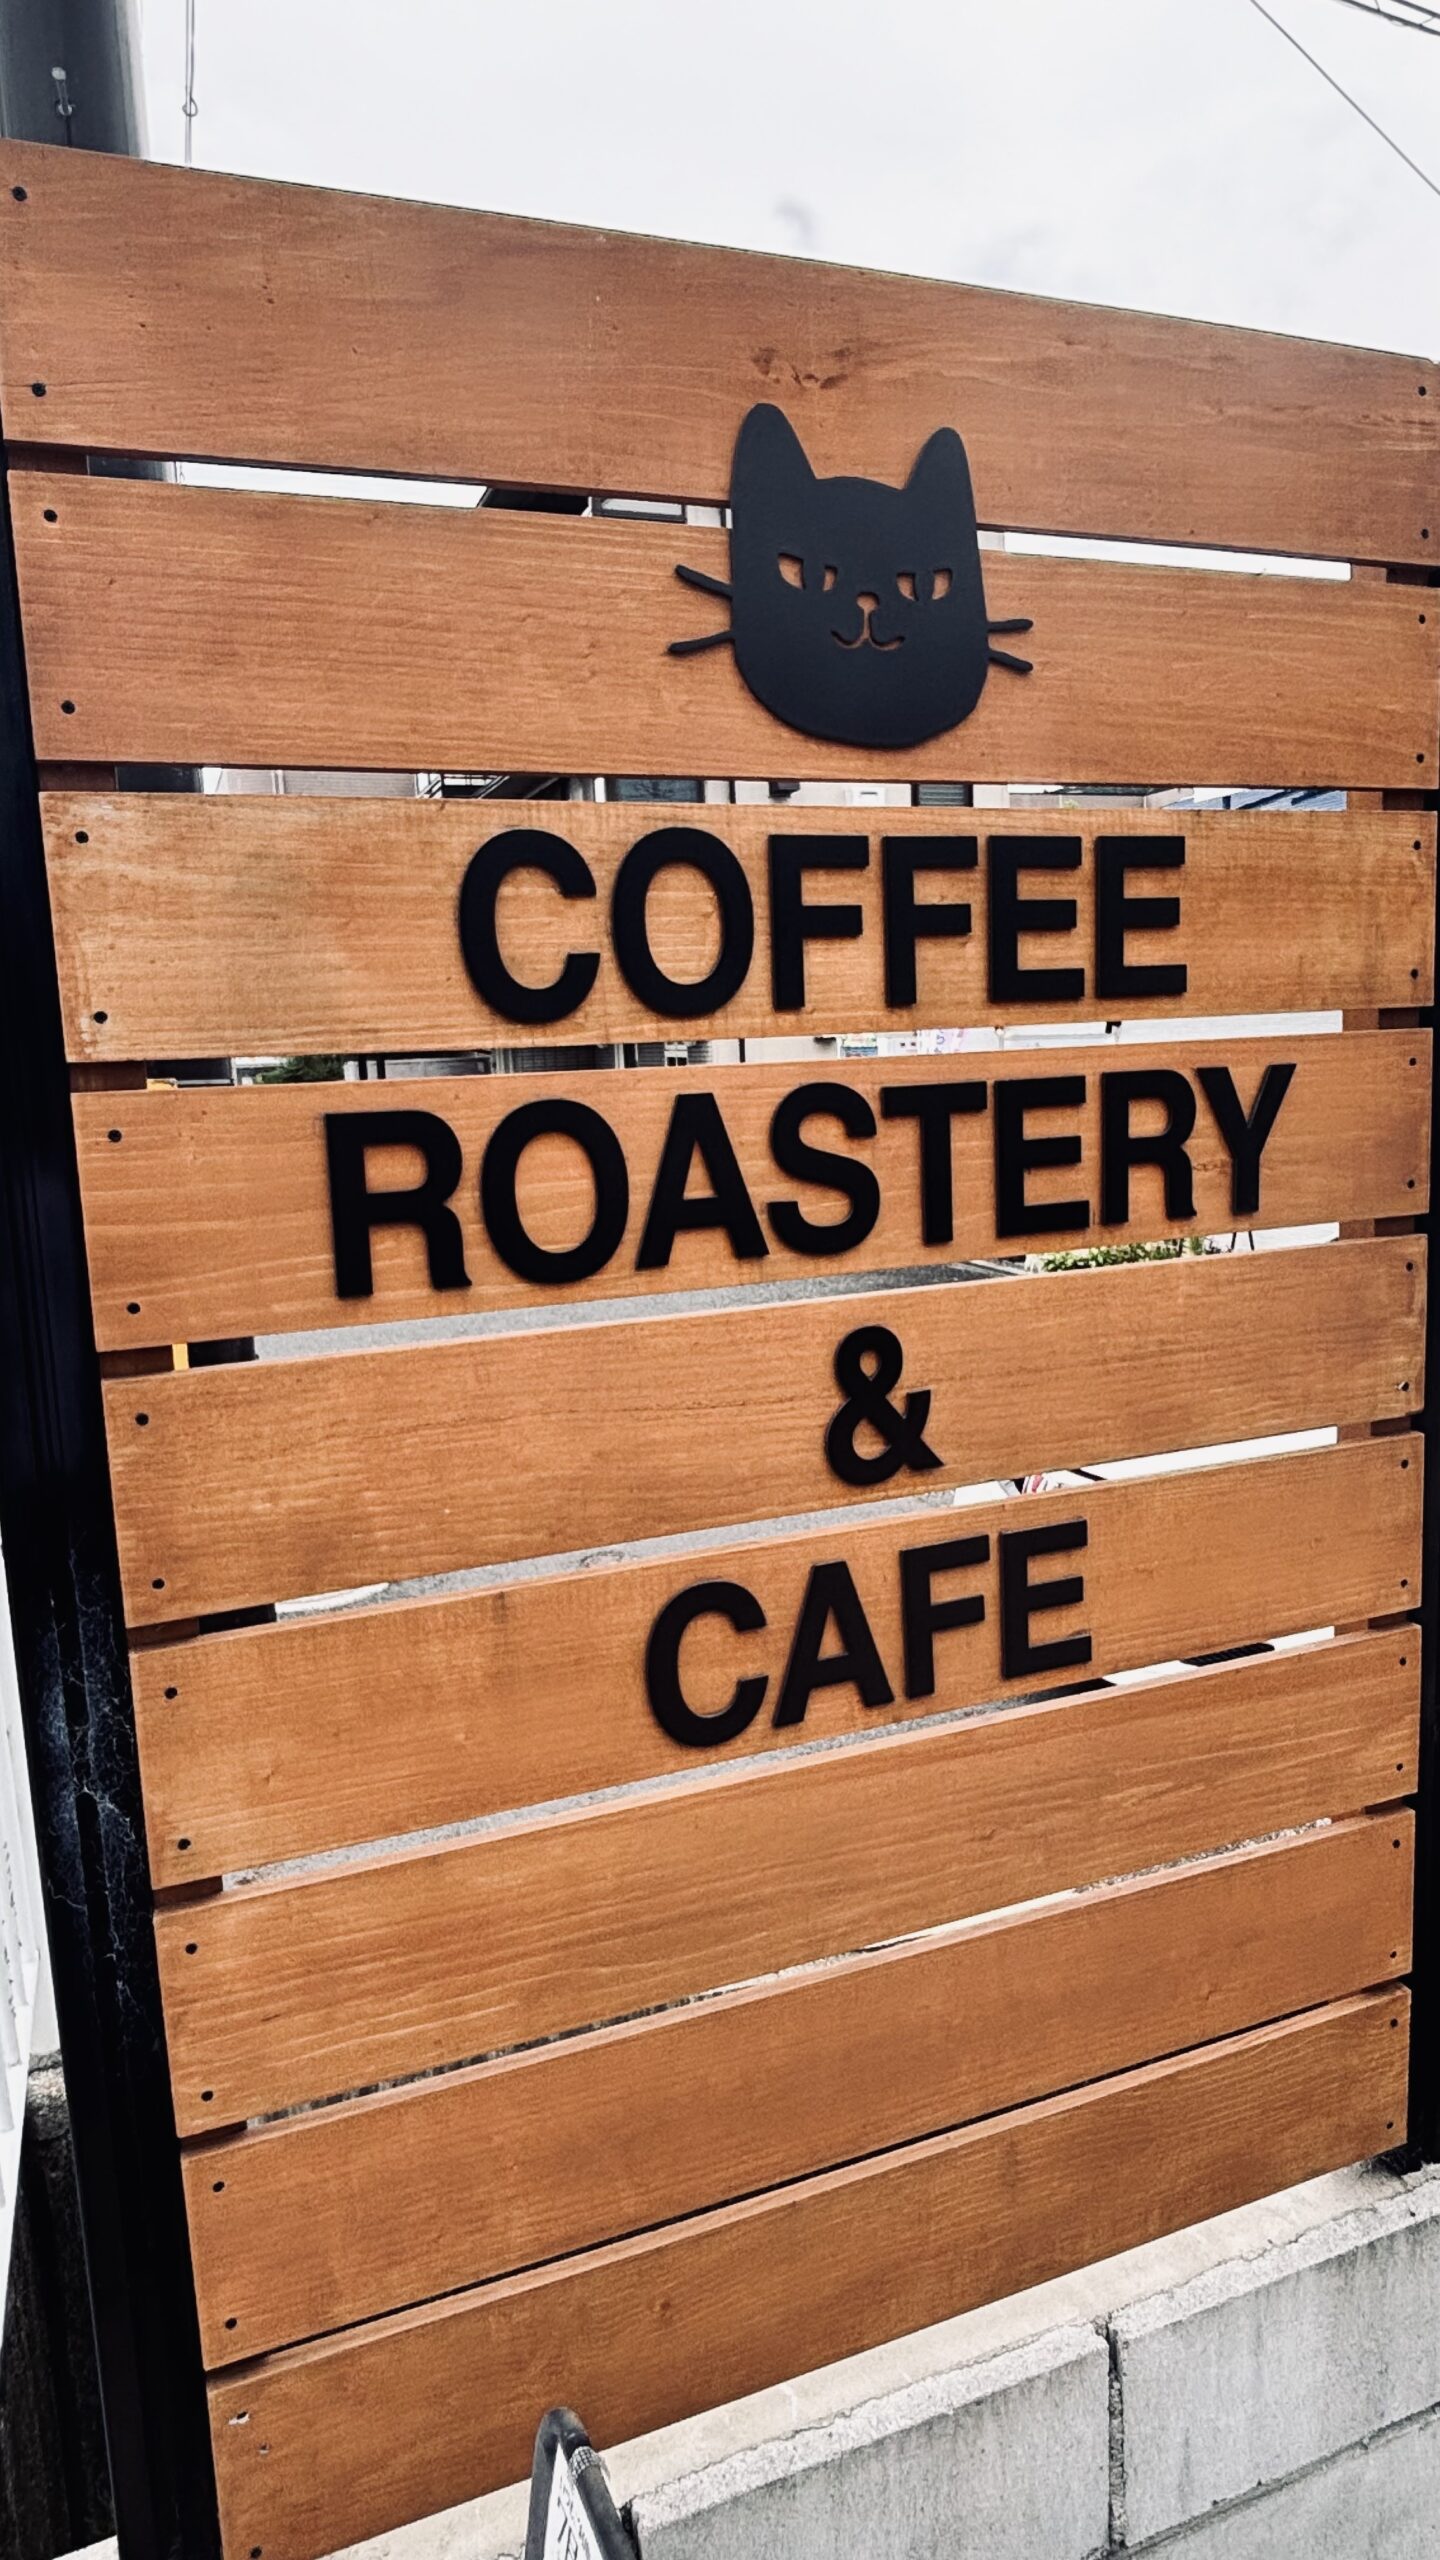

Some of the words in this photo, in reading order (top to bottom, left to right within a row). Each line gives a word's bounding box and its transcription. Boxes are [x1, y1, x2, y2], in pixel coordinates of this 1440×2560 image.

[457, 827, 1187, 1024] COFFEE
[323, 1065, 1296, 1301] ROASTERY
[825, 1326, 943, 1487] &
[645, 1520, 1092, 1749] CAFE
